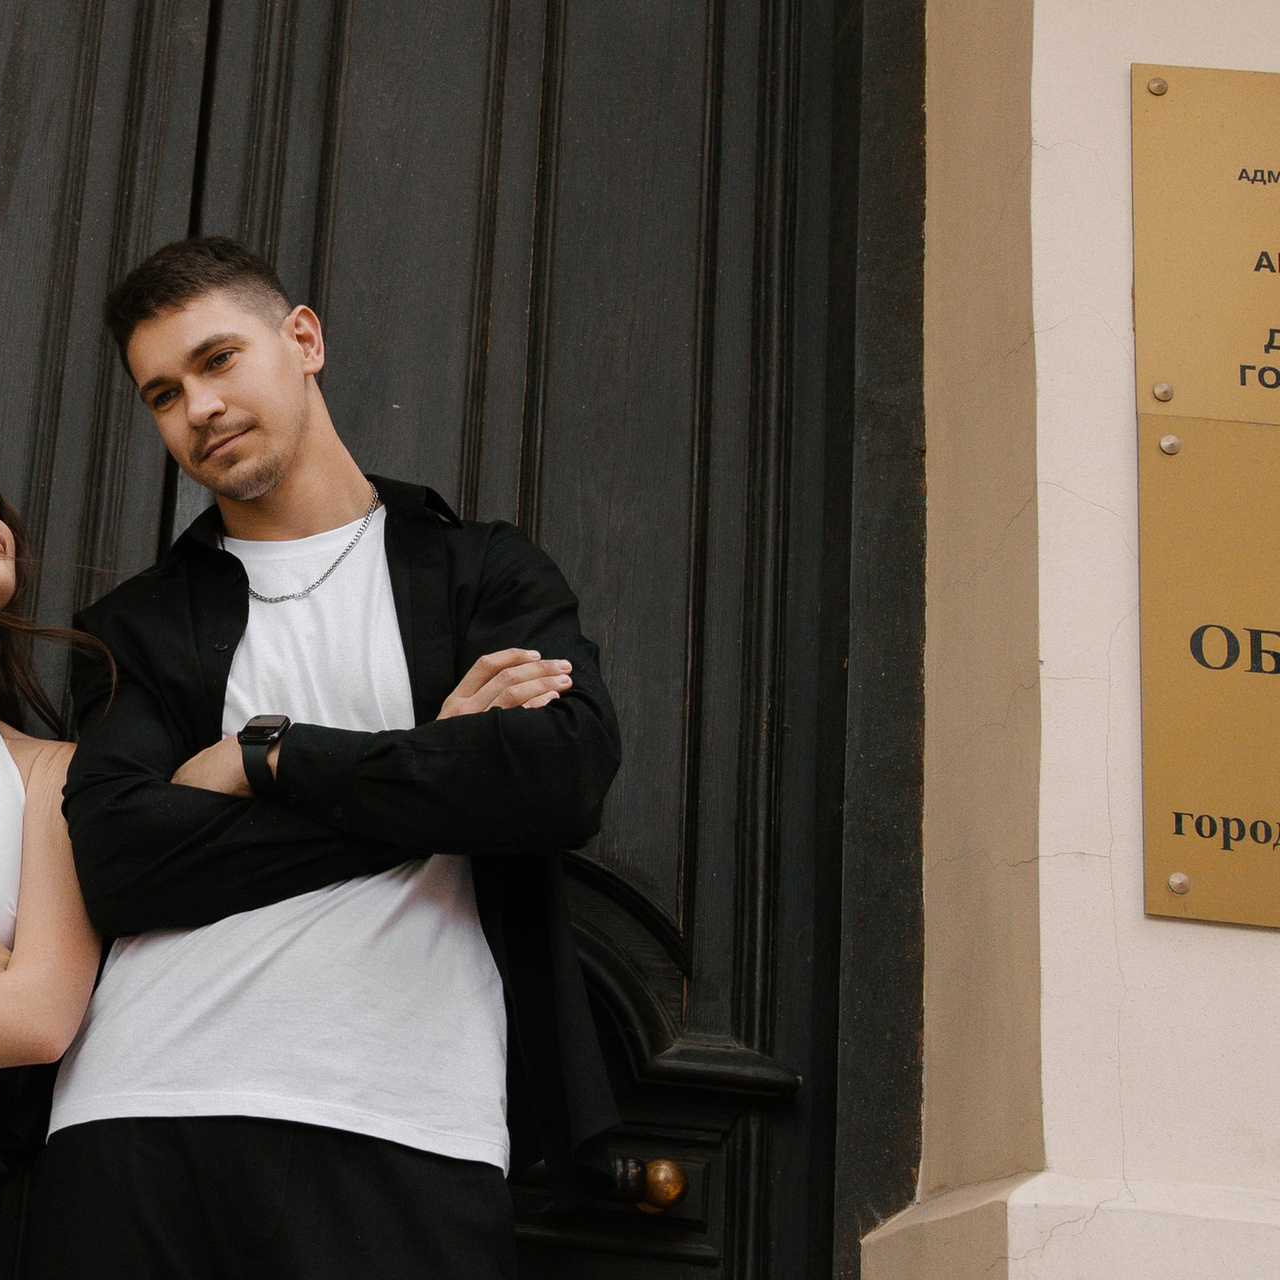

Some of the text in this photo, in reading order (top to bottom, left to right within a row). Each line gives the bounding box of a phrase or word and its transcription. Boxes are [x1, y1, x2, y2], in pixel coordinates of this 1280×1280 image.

[1253, 251, 1280, 273] А
[1189, 624, 1280, 675] ОБ
[1172, 811, 1280, 851] горо
